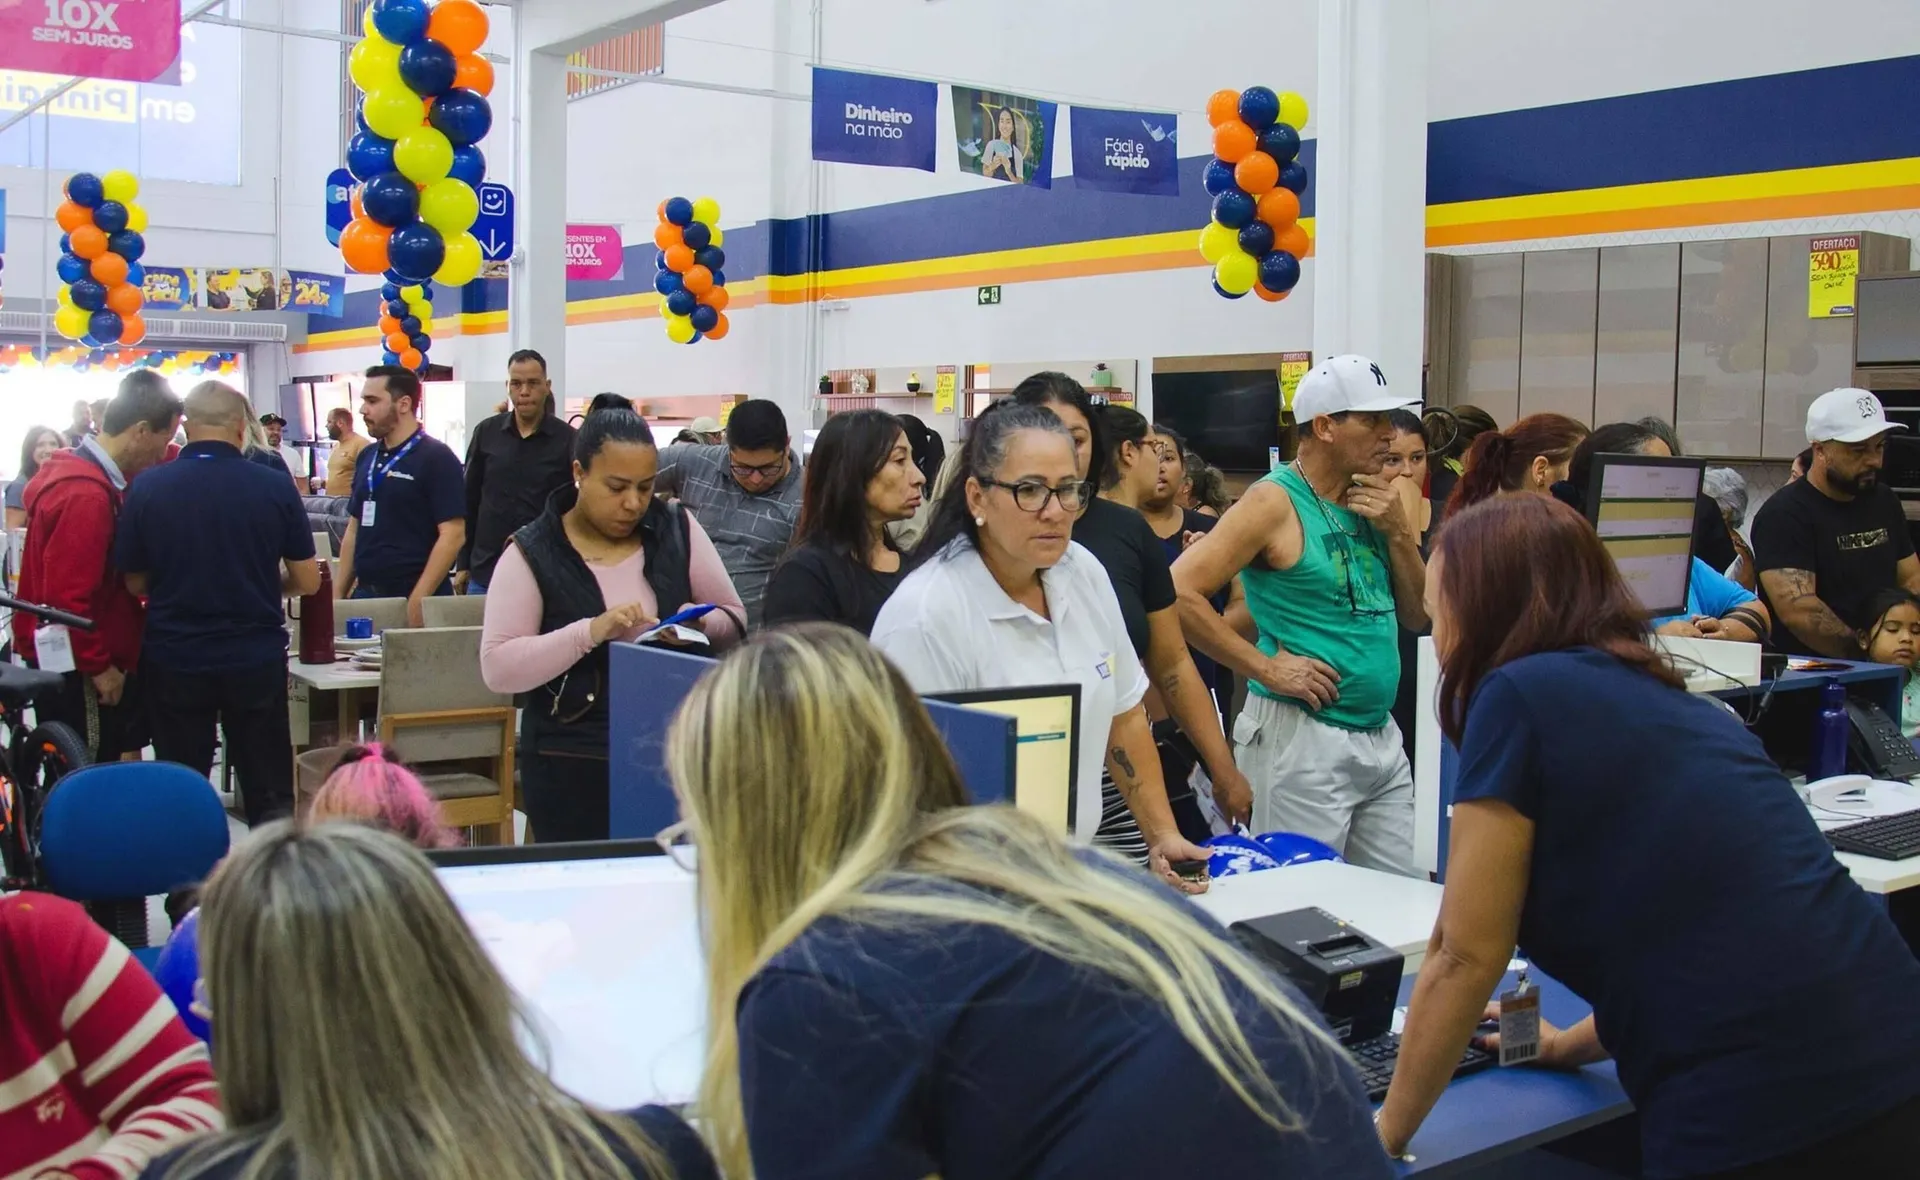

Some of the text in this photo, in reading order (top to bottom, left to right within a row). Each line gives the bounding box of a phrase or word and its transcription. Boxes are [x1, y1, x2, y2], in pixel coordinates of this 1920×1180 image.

[44, 0, 120, 32] 10X
[32, 27, 133, 49] SEM JUROS
[845, 102, 913, 125] Dinheiro
[845, 122, 903, 139] na mão
[1105, 137, 1144, 154] Fácil e
[1105, 153, 1150, 171] rápido
[566, 243, 596, 258] 10X
[1813, 238, 1855, 250] OFERTAÇO
[576, 258, 602, 266] JUROS
